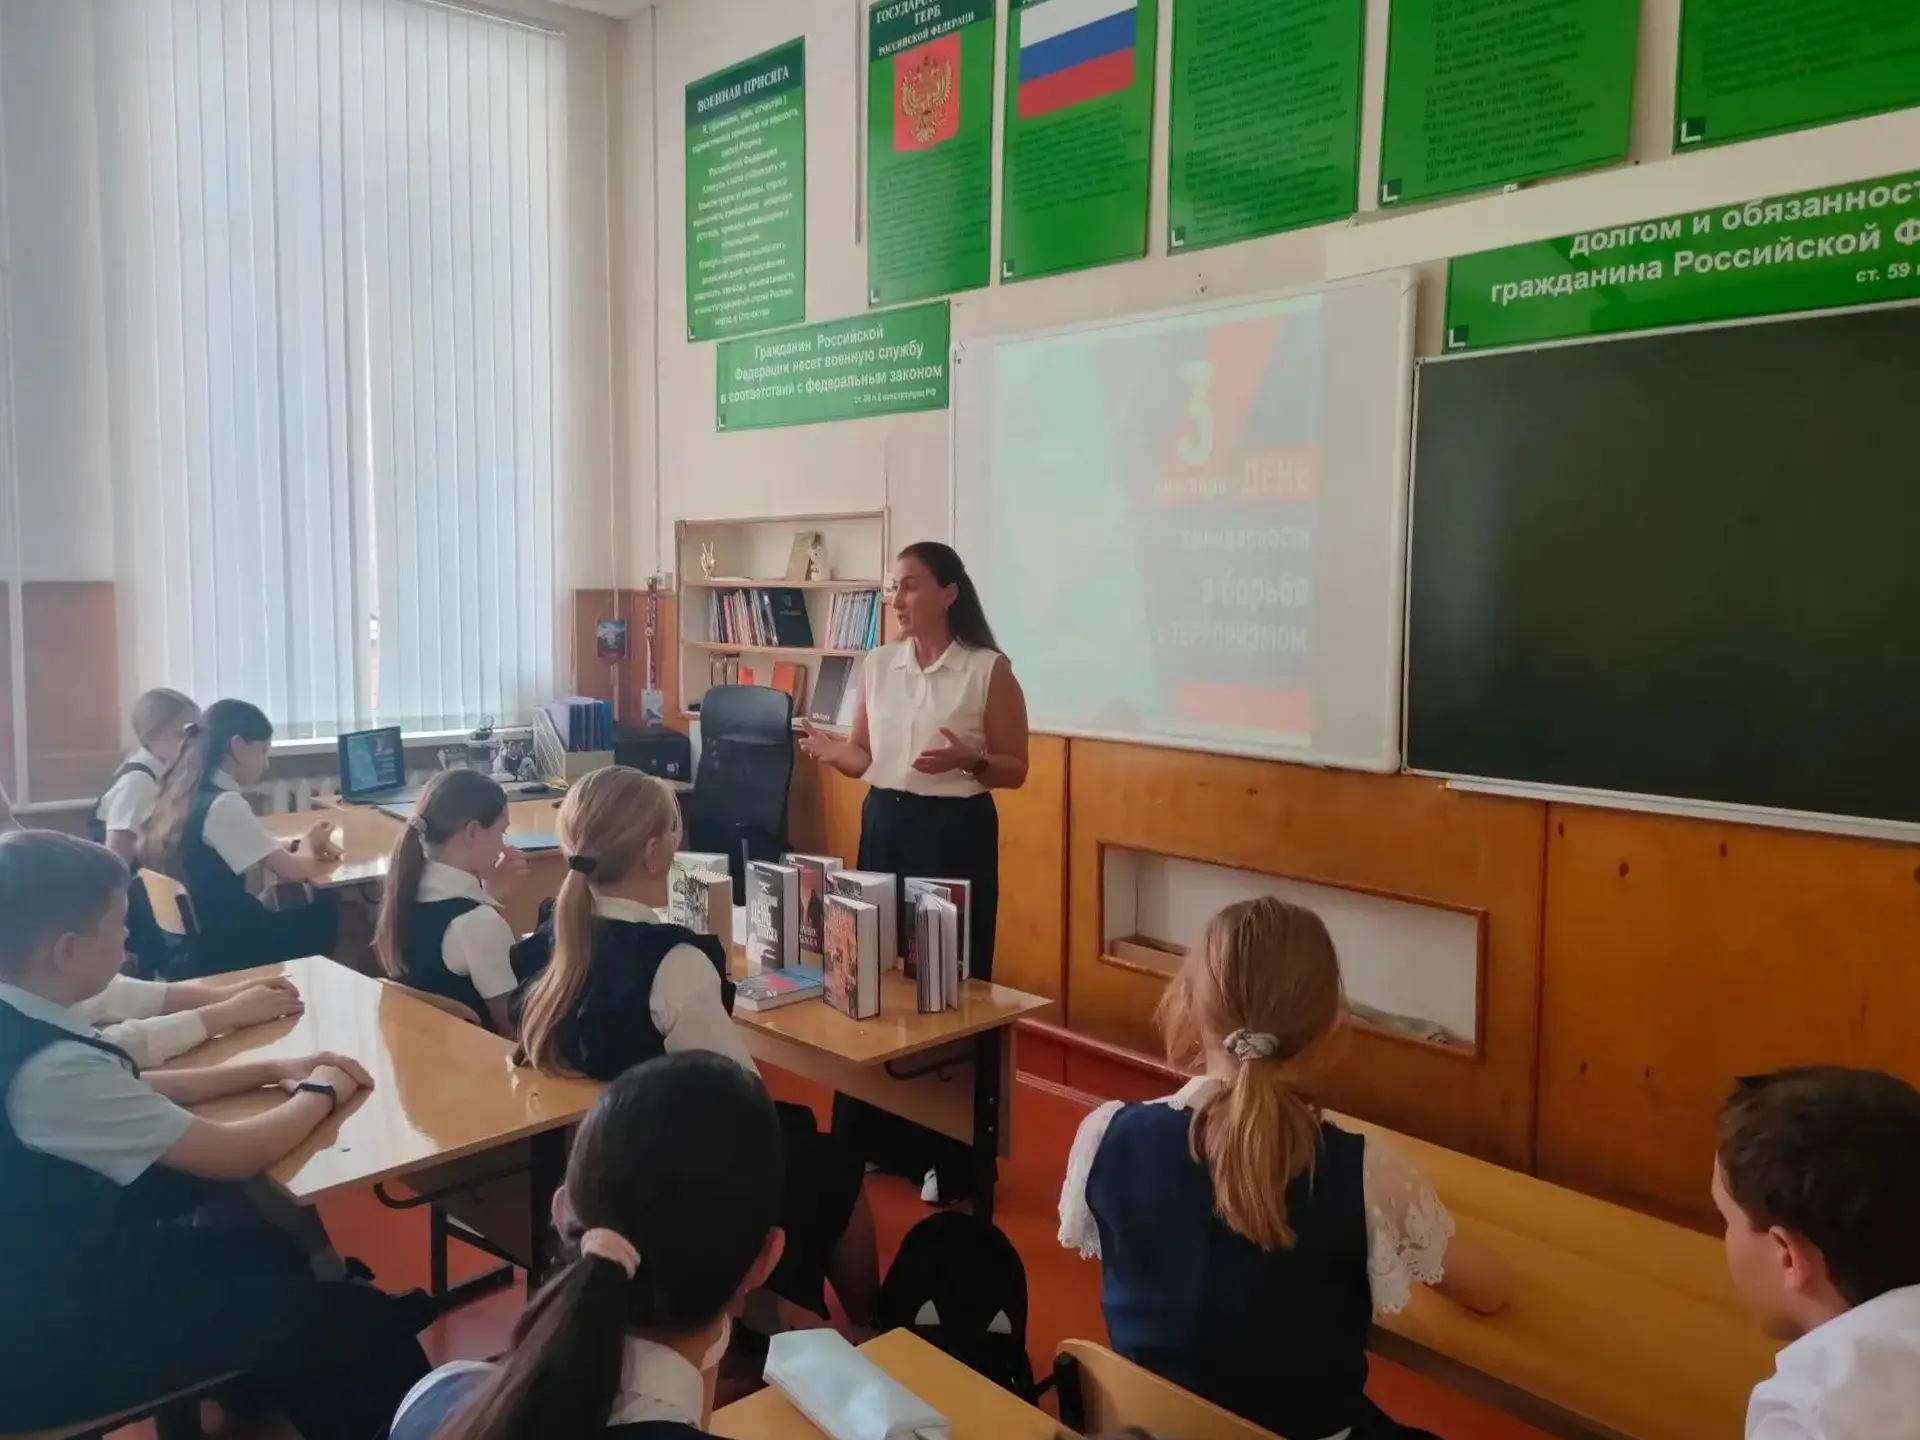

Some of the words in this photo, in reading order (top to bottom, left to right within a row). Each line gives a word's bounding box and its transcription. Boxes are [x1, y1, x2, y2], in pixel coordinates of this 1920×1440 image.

[876, 0, 934, 24] ГОСУДАРС
[914, 5, 941, 26] ГЕРБ
[878, 28, 929, 56] РОССИЙСКОЙ
[697, 85, 741, 113] ВОЕННАЯ
[743, 65, 790, 94] ПРИСЯГА
[1570, 219, 1681, 262] долгом
[1691, 212, 1711, 236] и
[1491, 257, 1662, 306] гражданина
[1673, 221, 1881, 277] Российской
[1855, 269, 1880, 283] ст.
[1887, 261, 1911, 280] 59
[734, 361, 790, 383] Федерации
[792, 358, 822, 374] несет
[824, 350, 875, 369] военную
[878, 338, 924, 363] службу
[754, 341, 812, 362] Гражданин
[816, 323, 885, 350] Российской
[720, 394, 728, 405] в
[728, 382, 795, 406] соответствии
[796, 382, 804, 394] с
[805, 370, 887, 394] федеральным
[889, 364, 943, 384] законом
[925, 387, 937, 397] РФ
[1176, 360, 1214, 466] 3
[1242, 456, 1313, 499] ДЕНЬ
[1221, 568, 1310, 614] борьбе
